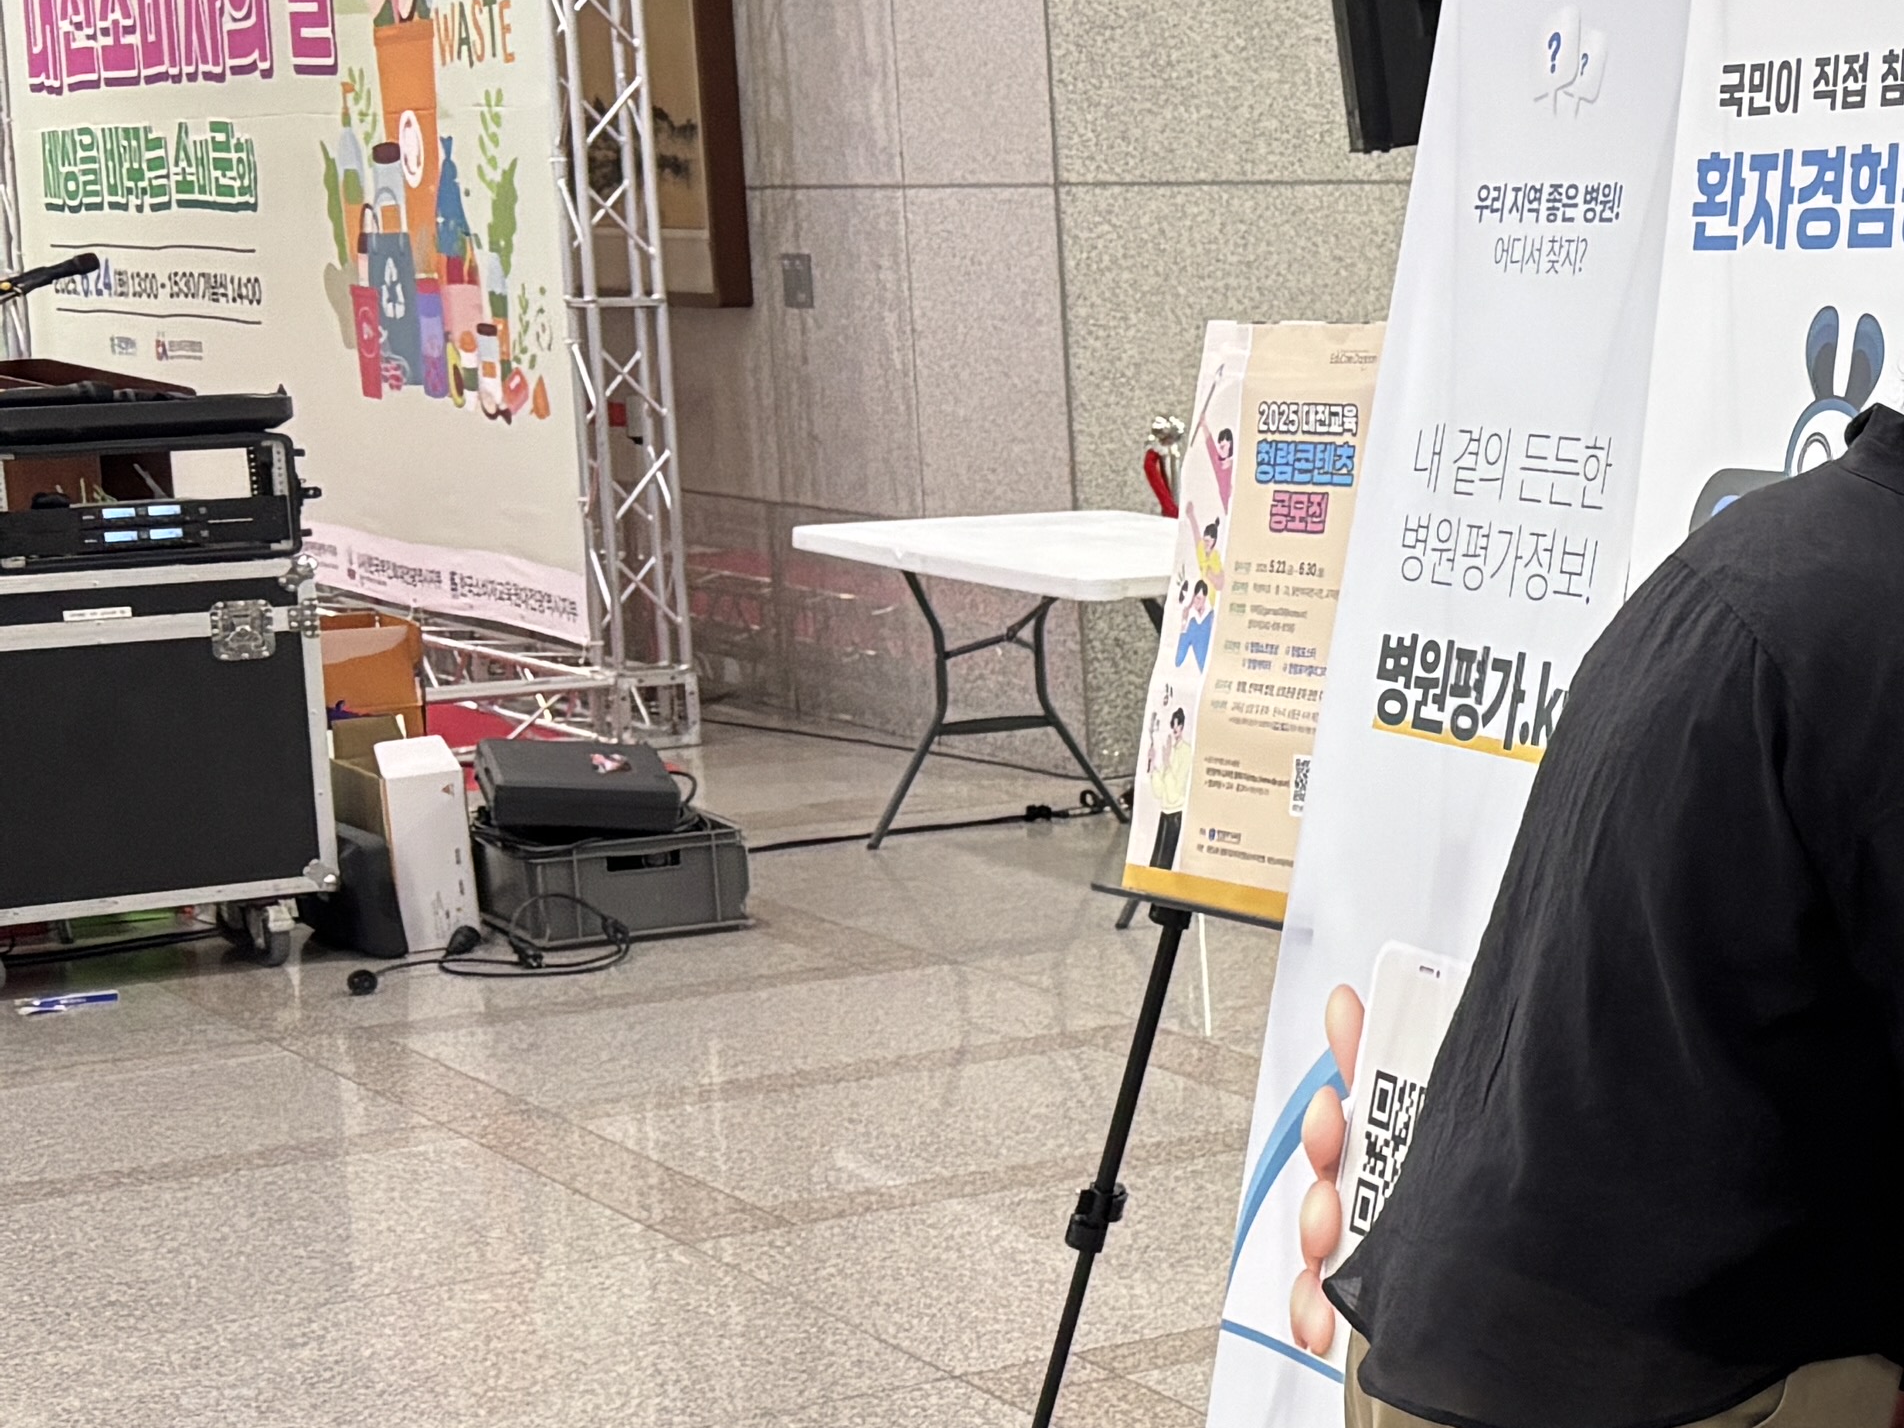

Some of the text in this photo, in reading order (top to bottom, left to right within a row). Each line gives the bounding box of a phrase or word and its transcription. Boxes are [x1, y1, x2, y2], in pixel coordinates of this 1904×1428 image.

[1719, 57, 1802, 118] 국민이
[1813, 51, 1869, 111] 직접
[173, 121, 258, 214] 소비문화
[1474, 181, 1624, 224] 우리 지역 좋은 병원!
[1494, 234, 1589, 276] 어디서 찾지?
[1258, 401, 1358, 437] 2025 대전교육
[1255, 438, 1356, 487] 청렴콘텐츠
[1414, 422, 1613, 510] 내 곁의 든든한
[1269, 490, 1329, 534] 공모전
[1401, 513, 1598, 605] 병원평가정보!
[1376, 632, 1569, 751] 병원평가.k
